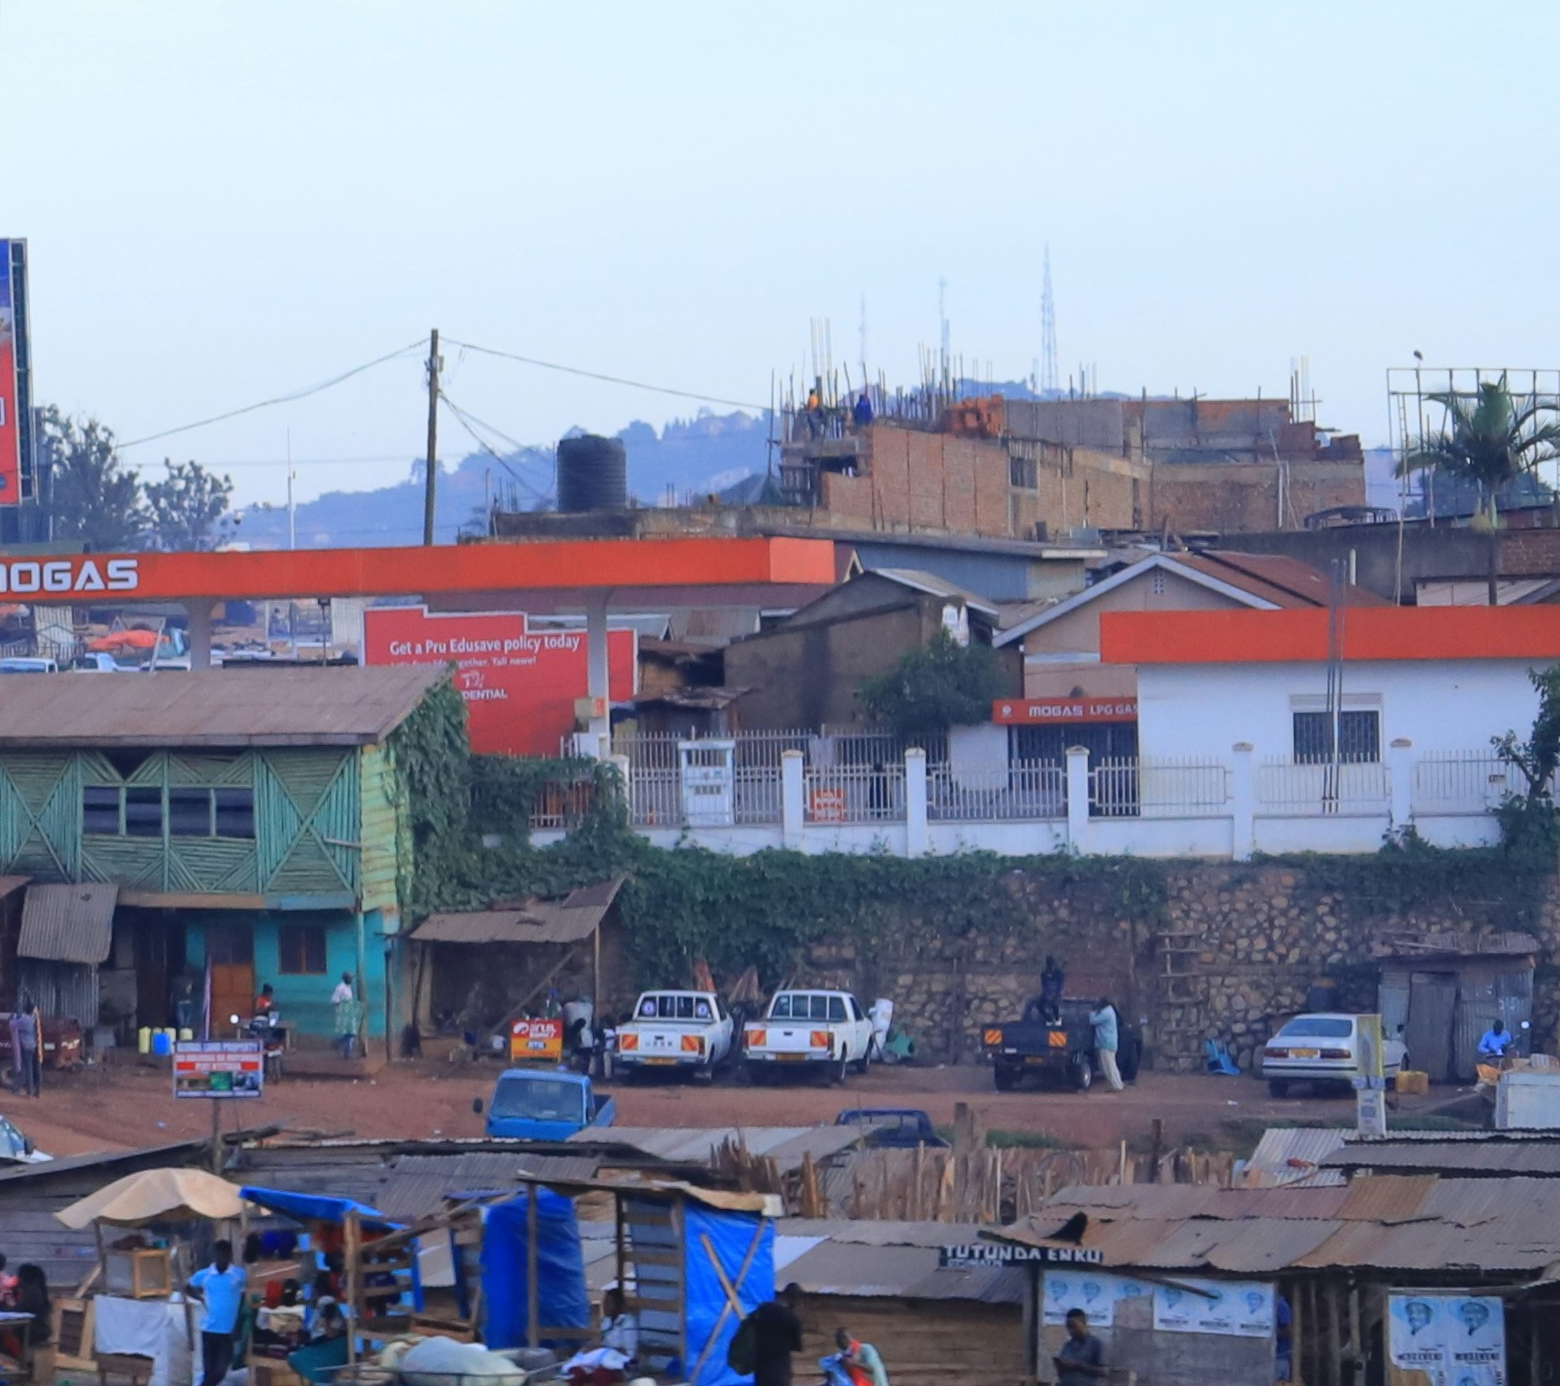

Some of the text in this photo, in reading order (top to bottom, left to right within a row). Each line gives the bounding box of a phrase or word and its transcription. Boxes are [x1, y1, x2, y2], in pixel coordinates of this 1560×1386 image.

[390, 633, 580, 655] Get a Pru Edusave policy today
[1090, 704, 1113, 716] LPG
[946, 1244, 1101, 1263] TUTUNDA ENKU
